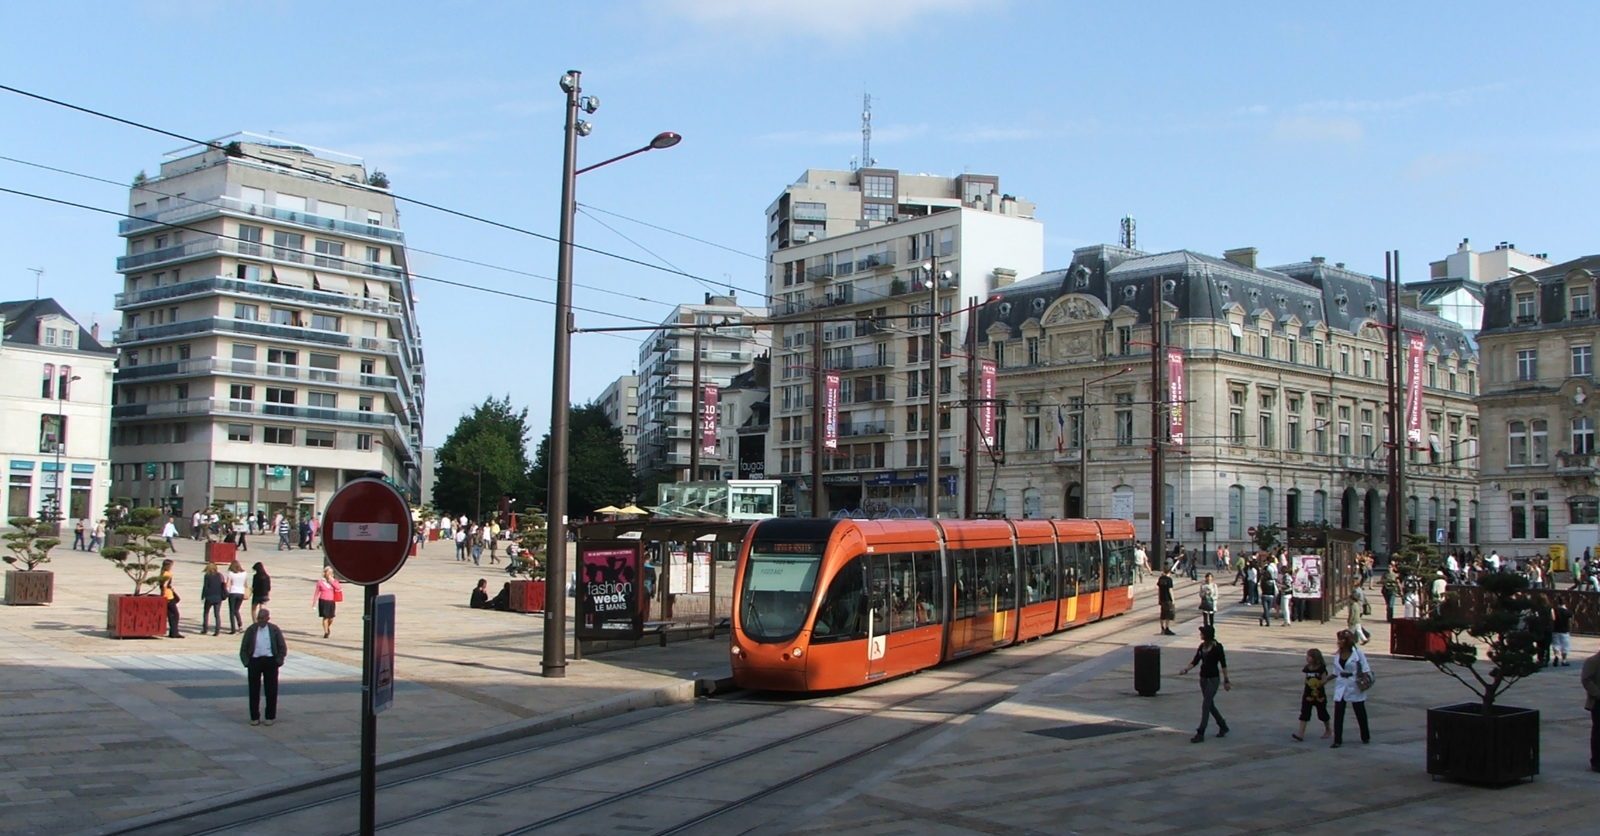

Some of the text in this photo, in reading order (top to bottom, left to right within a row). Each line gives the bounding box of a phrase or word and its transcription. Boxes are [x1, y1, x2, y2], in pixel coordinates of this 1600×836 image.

[705, 405, 715, 414] 10
[704, 421, 714, 430] 14
[587, 580, 632, 595] fashion
[593, 592, 626, 604] week
[595, 603, 627, 612] LE MANS
